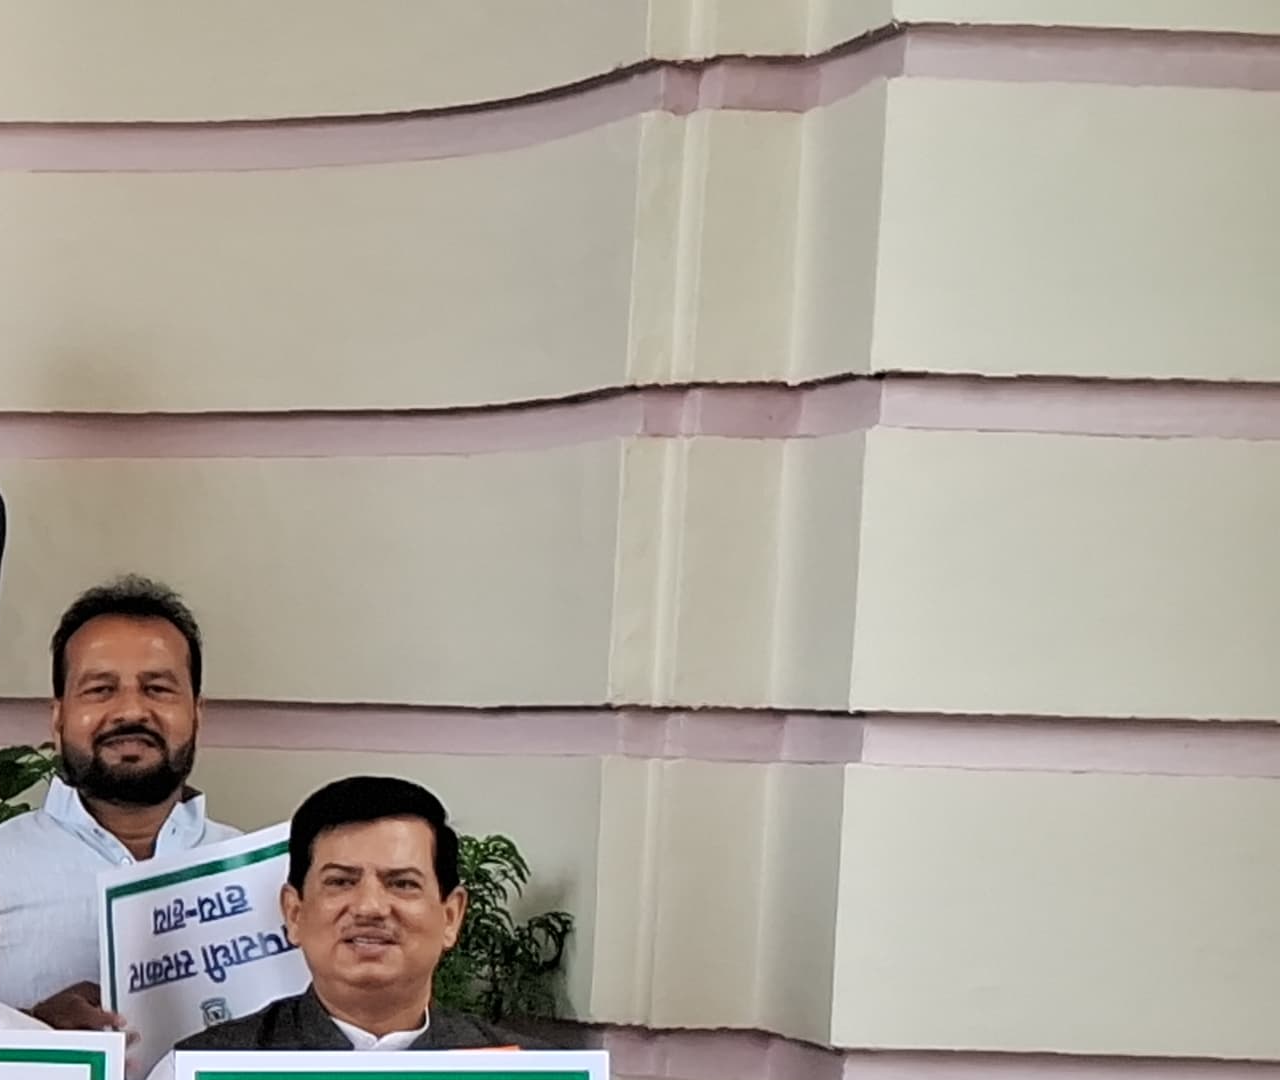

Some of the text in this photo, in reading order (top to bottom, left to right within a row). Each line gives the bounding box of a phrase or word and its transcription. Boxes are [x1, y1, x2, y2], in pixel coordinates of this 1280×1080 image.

[153, 886, 251, 936] हाय-हाय
[129, 925, 299, 993] पराधी सरकार
